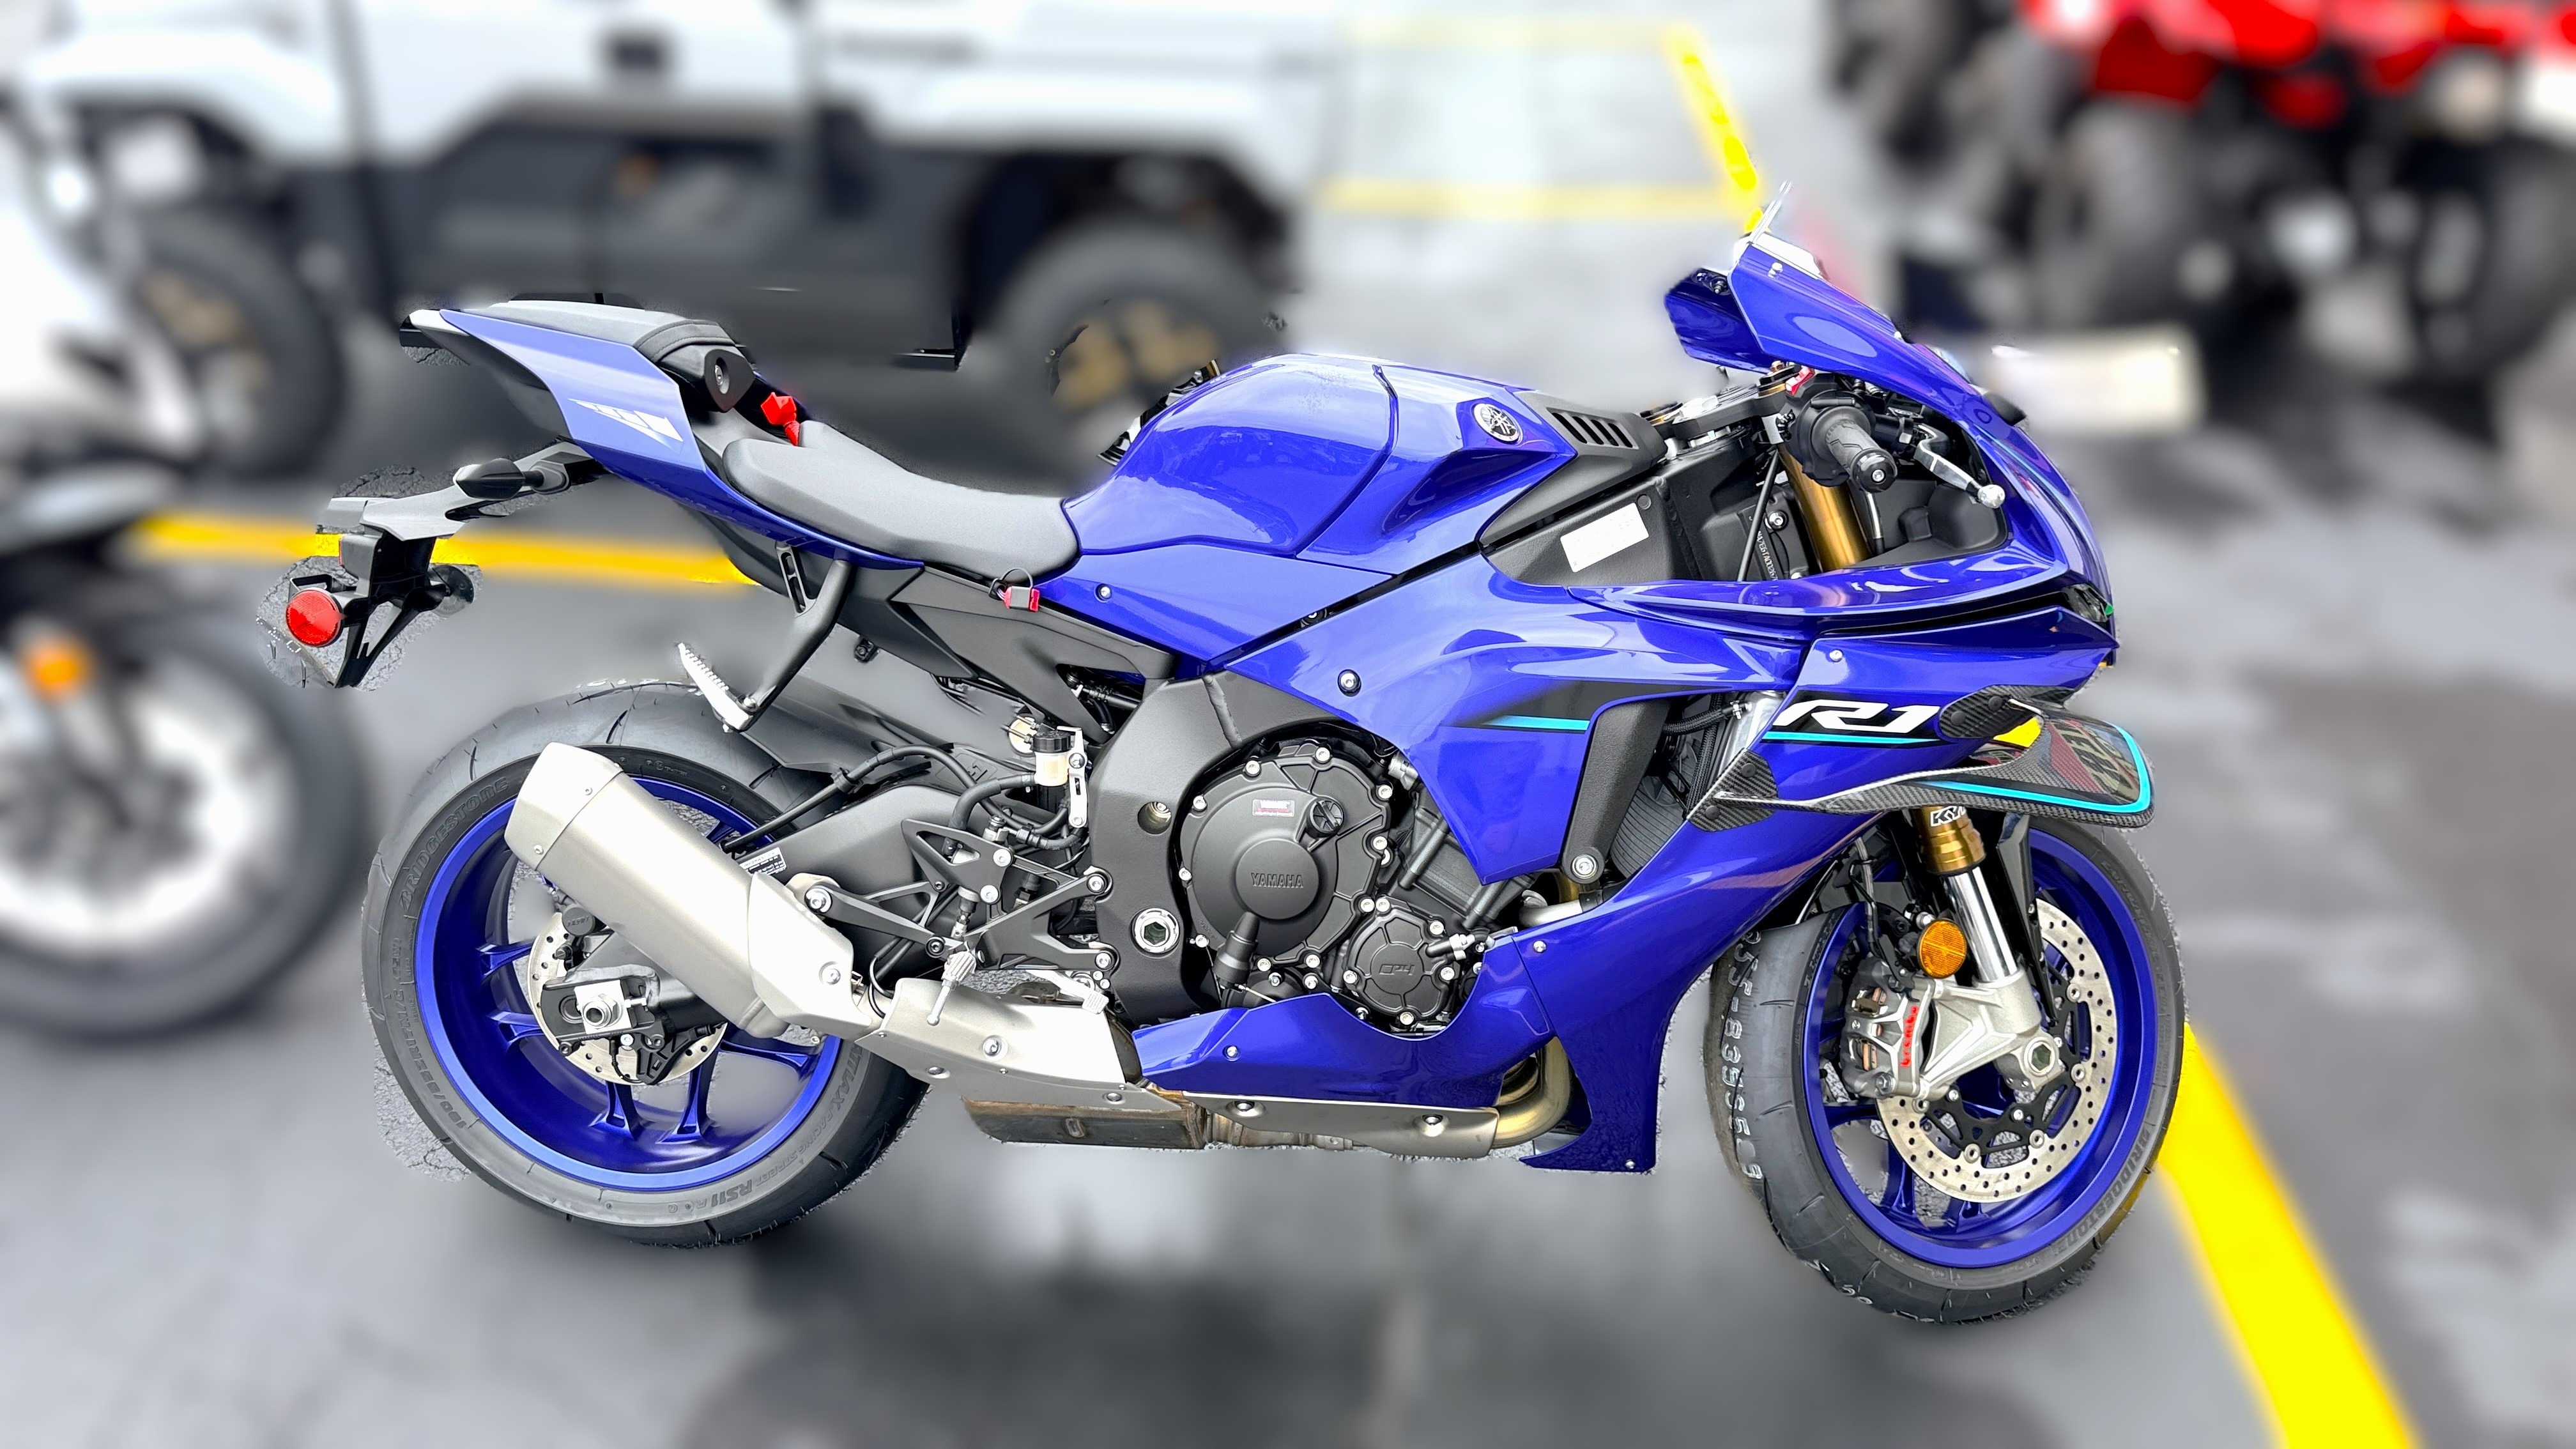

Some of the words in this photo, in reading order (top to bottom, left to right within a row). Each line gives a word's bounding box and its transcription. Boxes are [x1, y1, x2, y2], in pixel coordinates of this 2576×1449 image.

[1772, 699, 1940, 733] R1
[399, 776, 509, 911] BRIDGESTONE
[1251, 872, 1304, 888] YAMAHA
[1379, 963, 1415, 976] CP4
[798, 1110, 834, 1158] RACING
[756, 1152, 800, 1187] STREET
[710, 1179, 753, 1208] RS11
[2051, 1126, 2150, 1256] BRIDGESTONE
